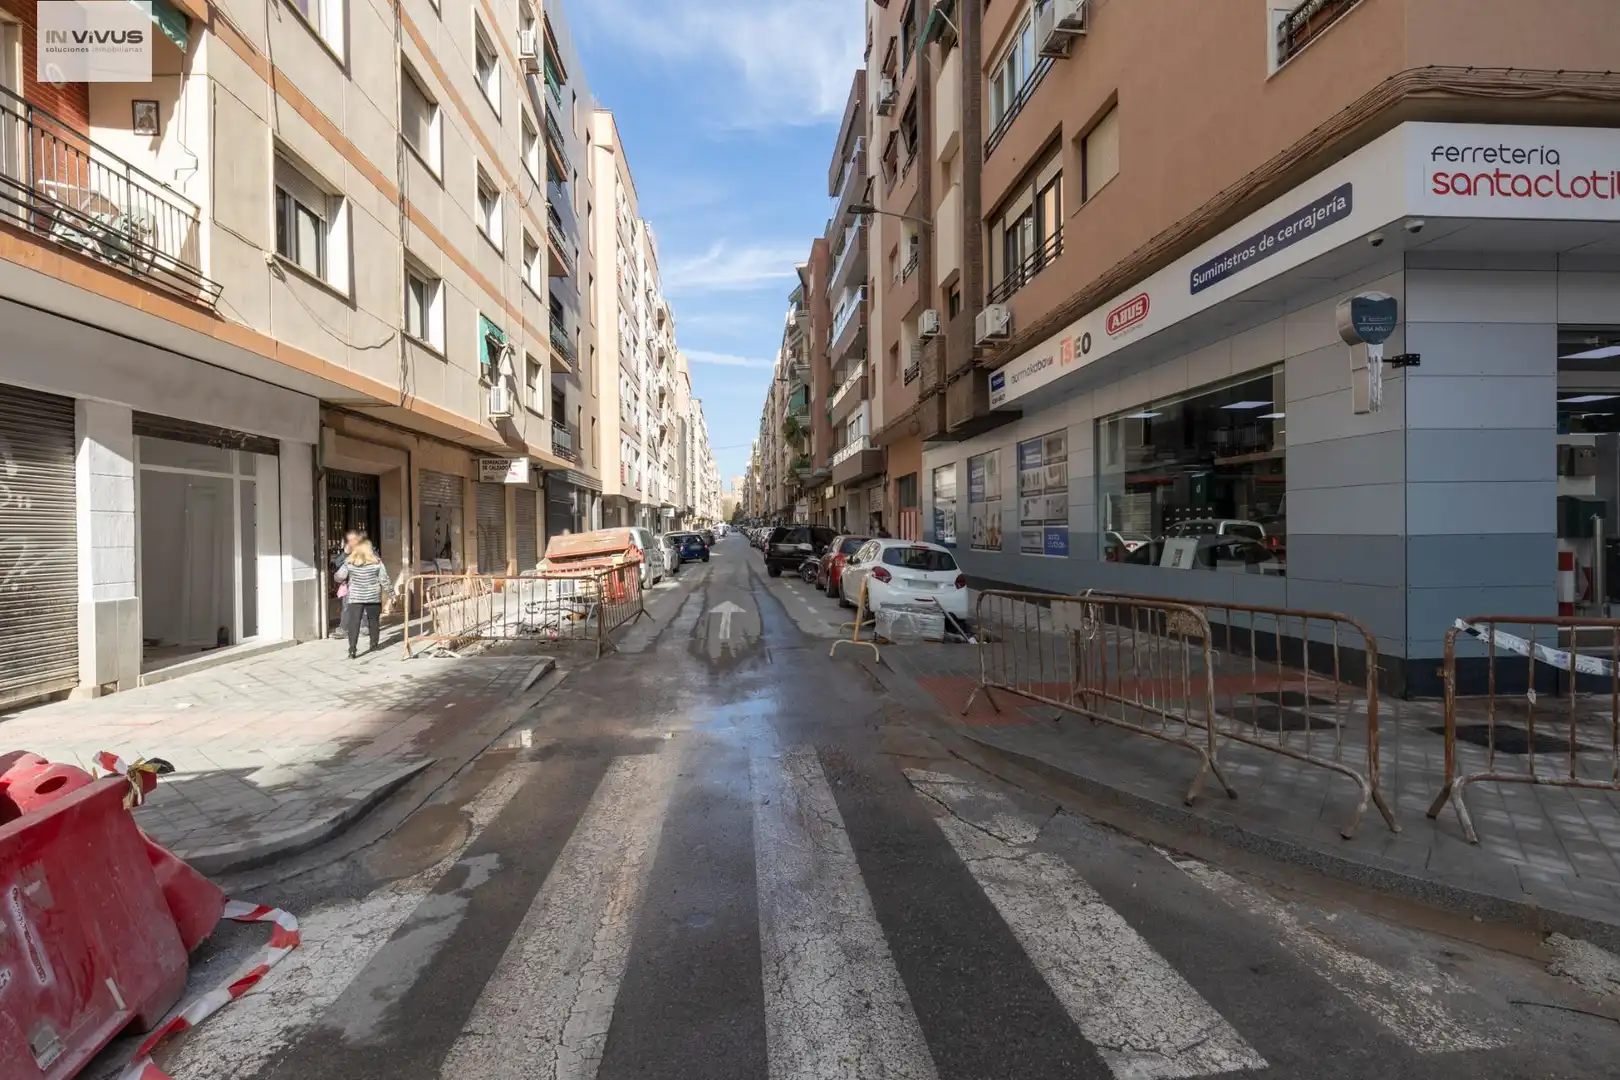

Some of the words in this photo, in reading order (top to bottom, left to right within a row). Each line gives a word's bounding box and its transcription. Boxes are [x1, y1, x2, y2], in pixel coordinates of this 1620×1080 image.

[1431, 143, 1560, 165] ferretería
[1193, 243, 1256, 287] Suministros
[1258, 234, 1275, 252] de
[1277, 195, 1347, 242] cerrajería
[1111, 299, 1143, 330] ABUS
